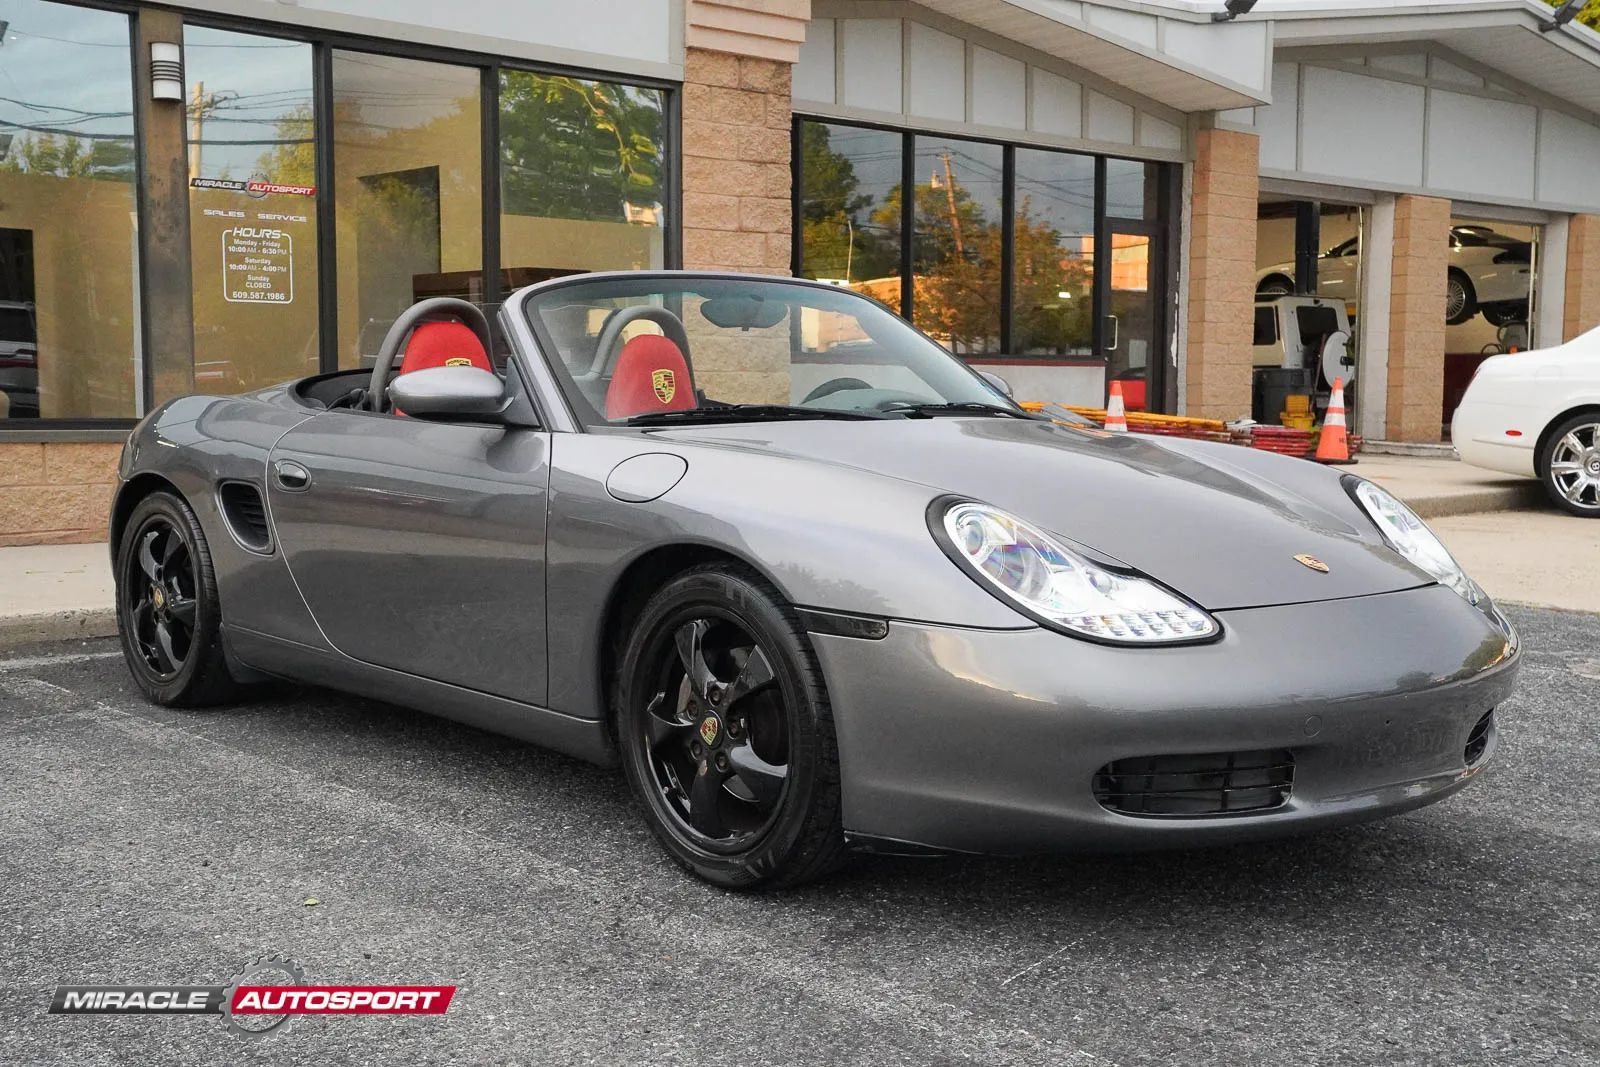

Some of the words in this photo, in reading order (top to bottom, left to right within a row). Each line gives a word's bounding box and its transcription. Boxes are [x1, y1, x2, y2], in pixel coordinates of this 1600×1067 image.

[195, 179, 242, 189] MIRACLE
[250, 183, 313, 195] AUTOSPORT
[203, 209, 245, 218] SALES
[257, 213, 307, 223] SERVICE
[233, 227, 282, 239] HOURS
[262, 240, 281, 248] Friday
[244, 256, 272, 265] Saturday
[247, 274, 270, 282] Sunday
[232, 291, 285, 300] 609.587.1986
